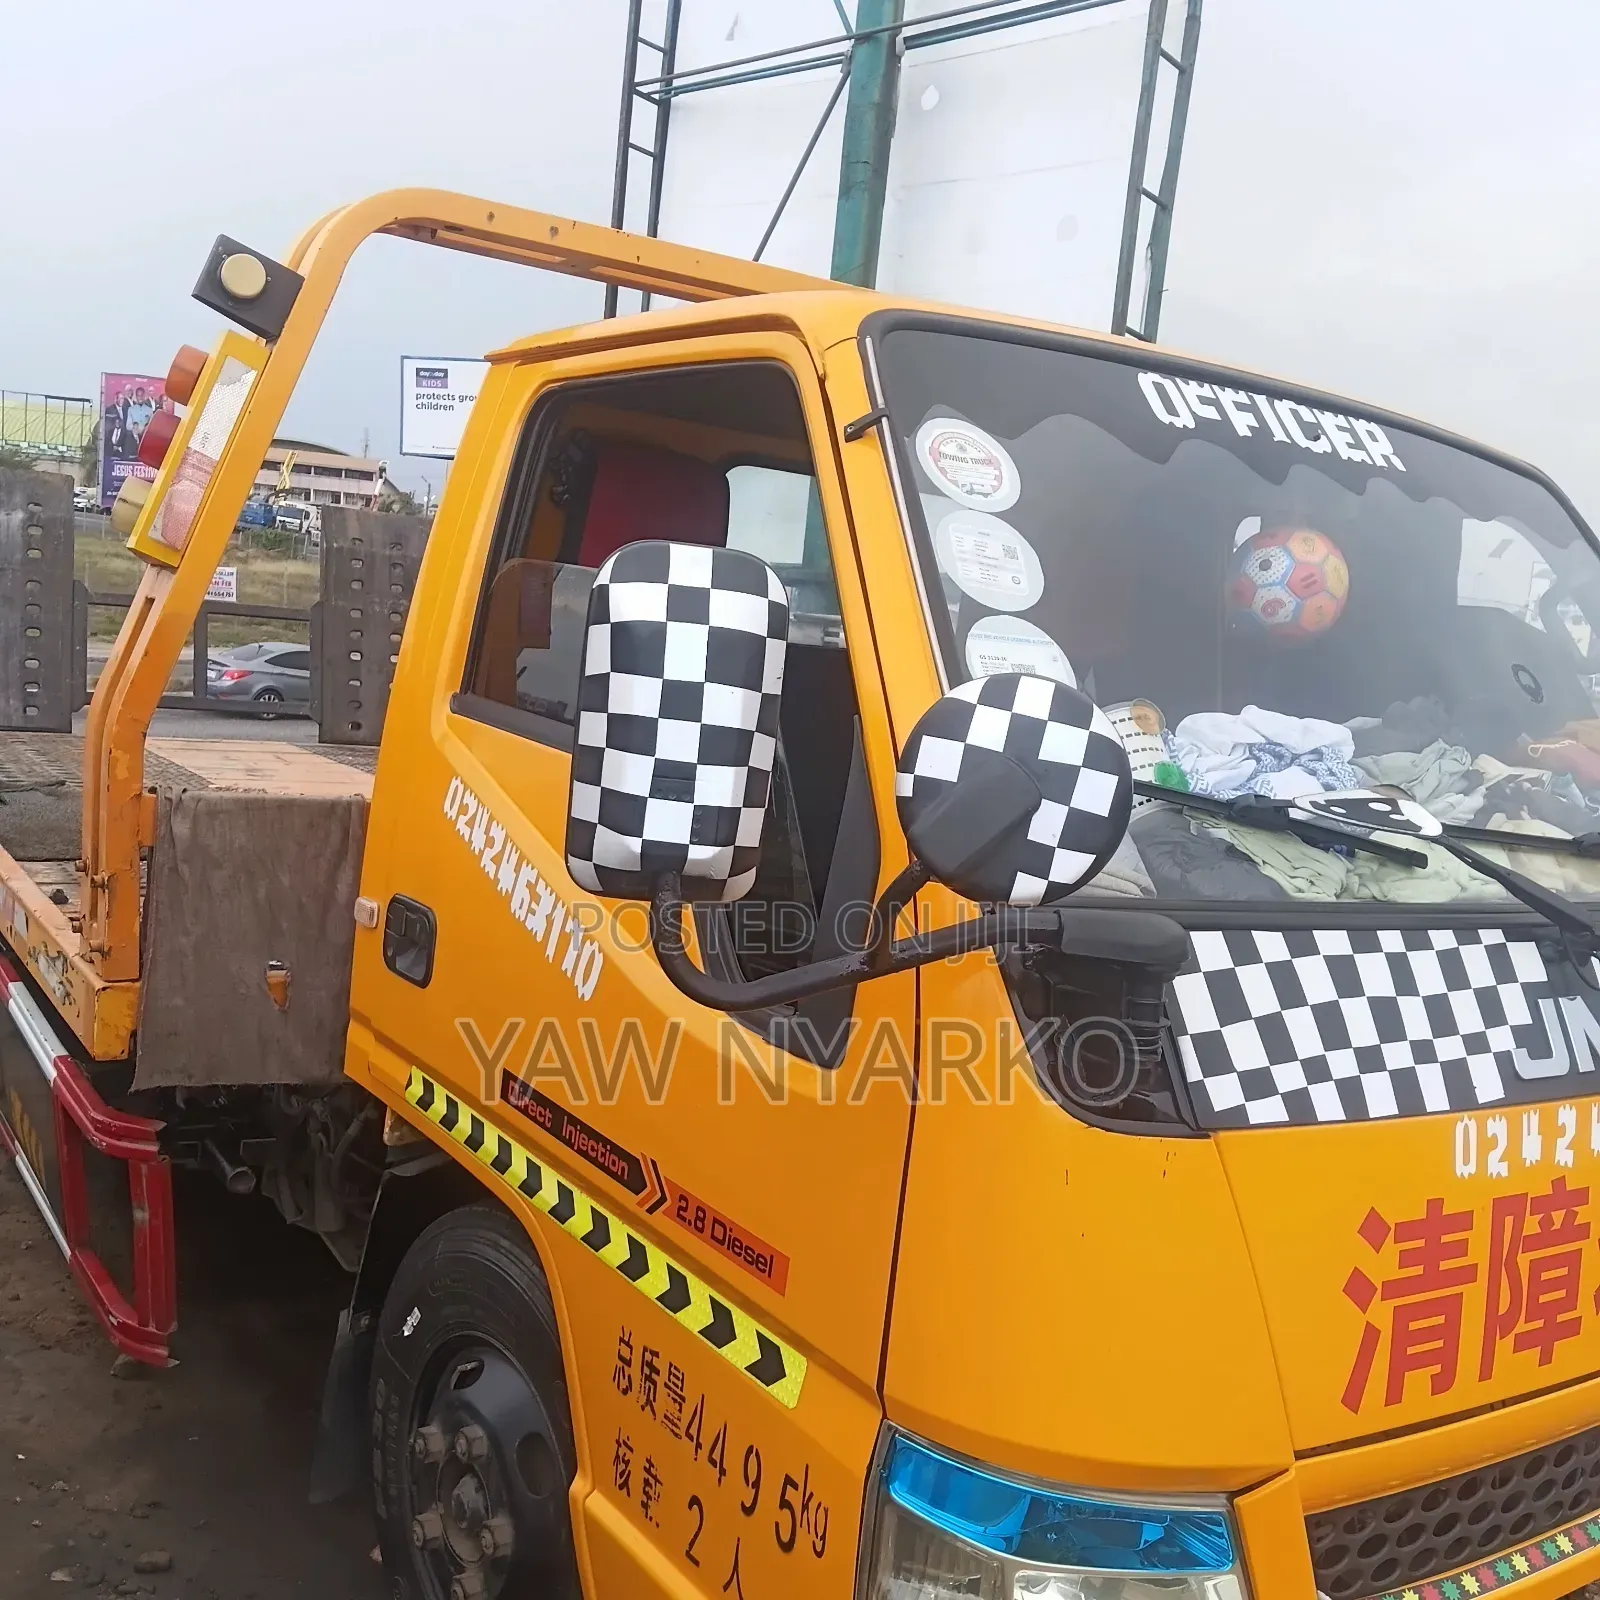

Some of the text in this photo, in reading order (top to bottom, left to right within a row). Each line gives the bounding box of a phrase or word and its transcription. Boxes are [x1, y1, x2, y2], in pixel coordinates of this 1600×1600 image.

[415, 392, 456, 401] protects
[415, 401, 455, 411] children
[422, 379, 442, 387] KIDS
[1137, 371, 1406, 472] OFFICER
[112, 464, 133, 476] JESUS
[939, 451, 993, 465] TOWING TRUCK
[443, 776, 604, 1002] 0242463170
[508, 1080, 629, 1180] Direct Injection
[676, 1194, 775, 1279] 2.8 Diesel
[1340, 1174, 1600, 1415] 清障
